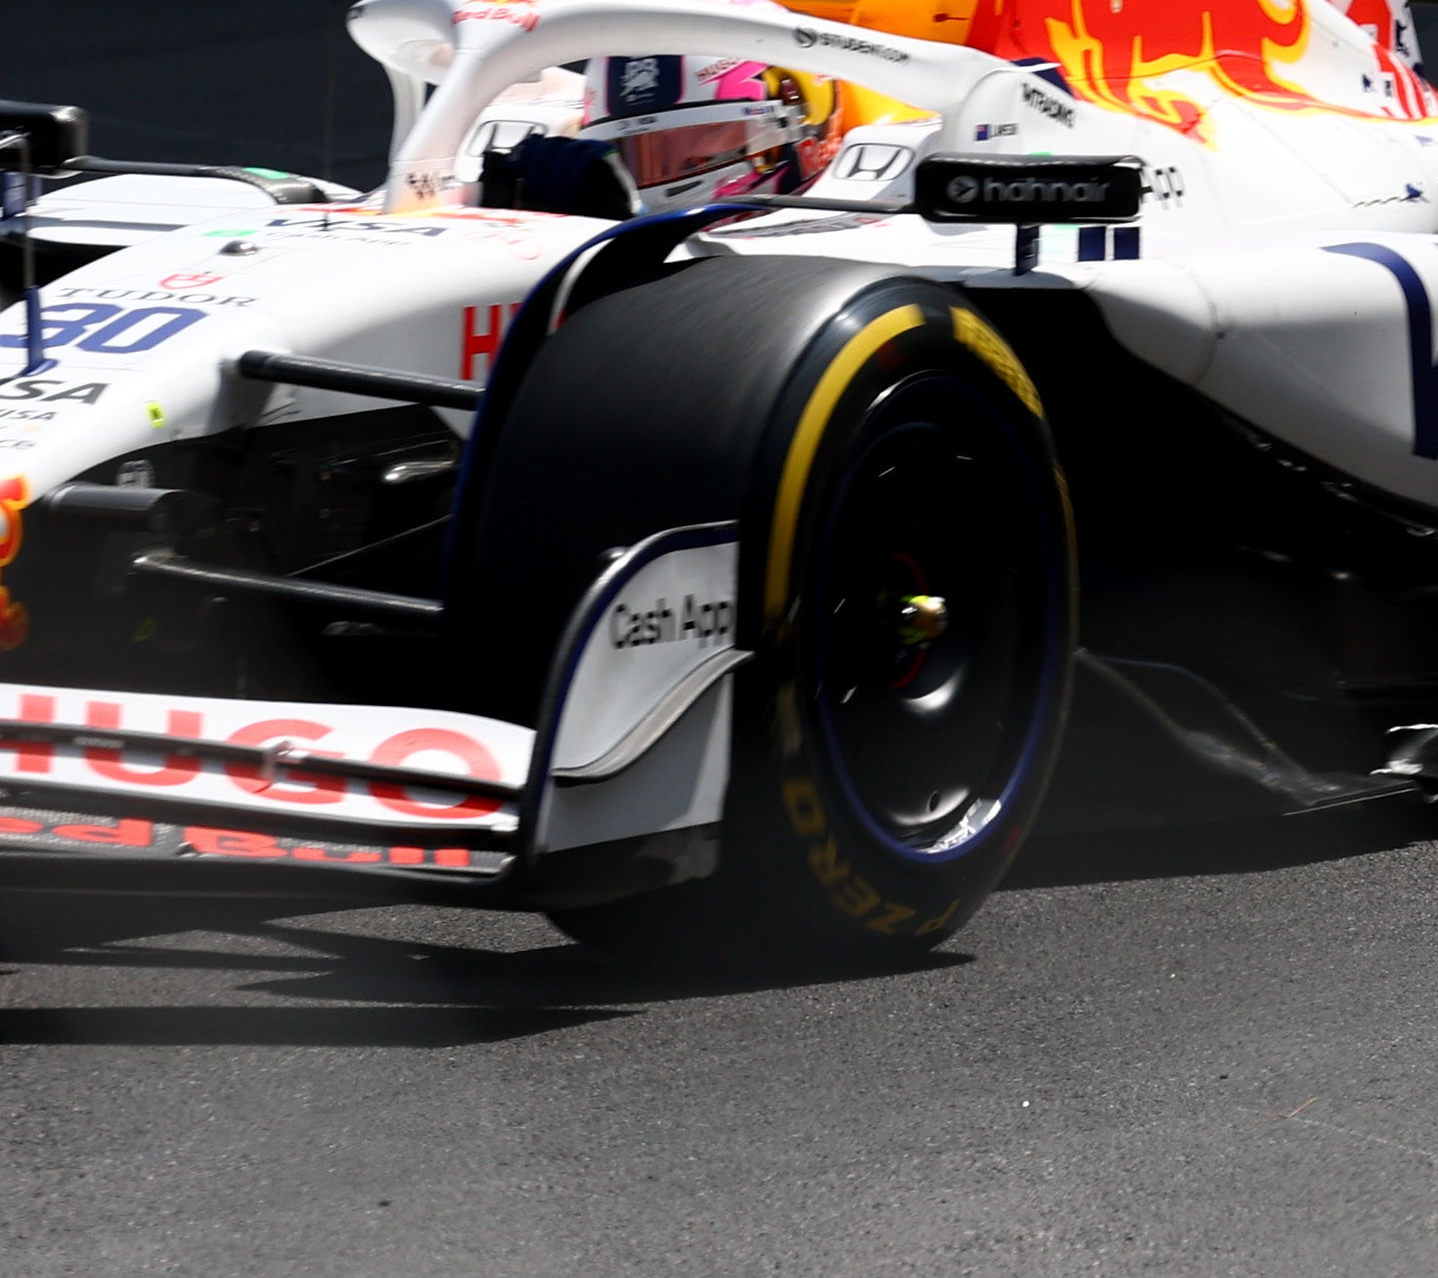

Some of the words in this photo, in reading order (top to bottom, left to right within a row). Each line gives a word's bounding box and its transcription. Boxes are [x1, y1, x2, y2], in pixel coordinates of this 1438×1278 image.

[982, 175, 1111, 202] hahnair
[263, 217, 451, 238] VISA
[59, 286, 256, 308] TUDOR
[608, 597, 675, 650] Cash
[678, 593, 735, 649] App
[179, 824, 471, 868] Bull
